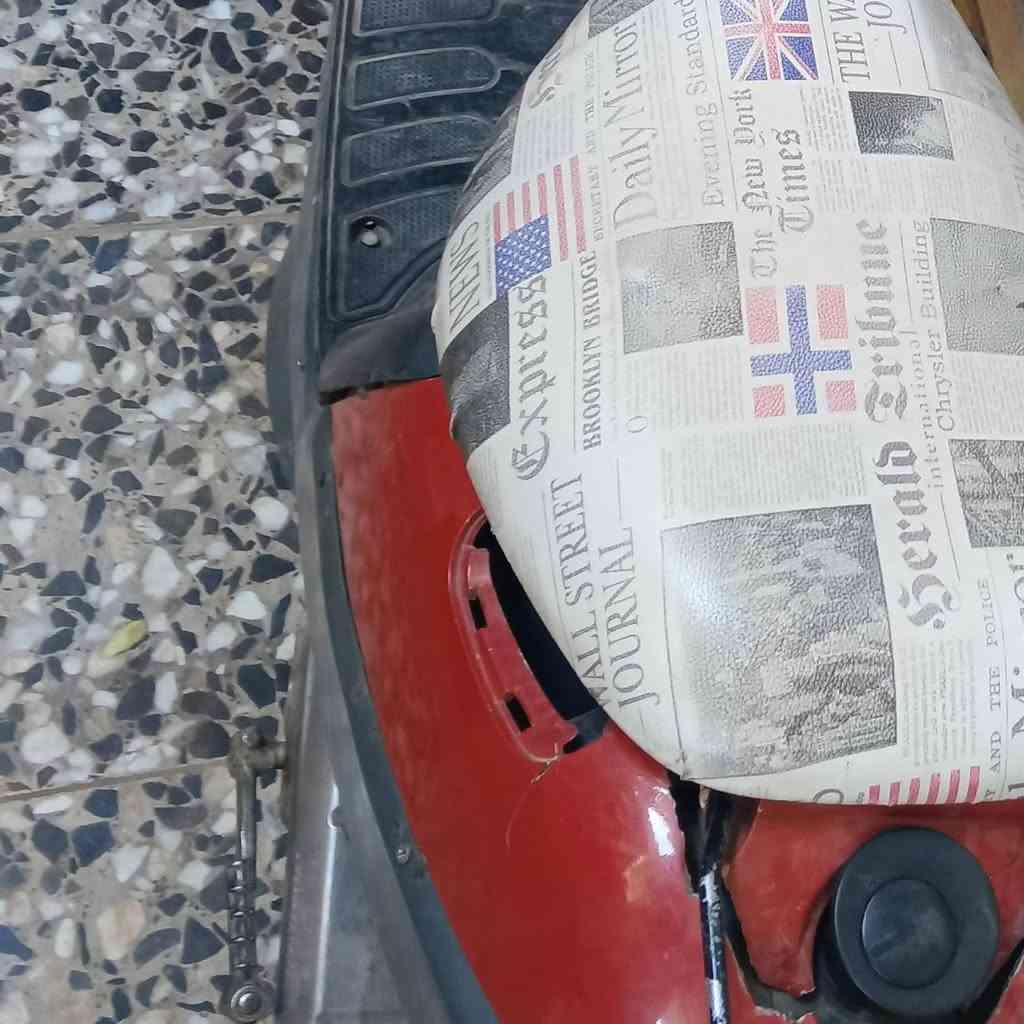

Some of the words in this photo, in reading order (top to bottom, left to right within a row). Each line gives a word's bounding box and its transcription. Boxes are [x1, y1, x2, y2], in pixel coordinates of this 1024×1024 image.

[832, 32, 870, 82] THE
[584, 96, 595, 121] THE
[694, 102, 724, 207] Evening
[728, 88, 765, 146] York
[742, 158, 772, 216] New
[771, 128, 814, 234] Times
[449, 222, 480, 333] NEWS
[578, 250, 600, 330] BRIDGE
[750, 229, 778, 278] The
[912, 219, 937, 319] Building
[854, 219, 908, 424] Tribune
[512, 275, 556, 480] Express
[582, 336, 602, 450] BROOKLYN
[900, 330, 944, 489] international
[928, 330, 955, 432] Chrysler
[550, 473, 594, 606] STREET
[872, 441, 960, 629] Herald
[571, 610, 611, 707] WALL
[598, 527, 660, 708] JOURNAL
[977, 578, 998, 647] POLICE
[989, 666, 1002, 710] THE
[990, 730, 1002, 774] AND
